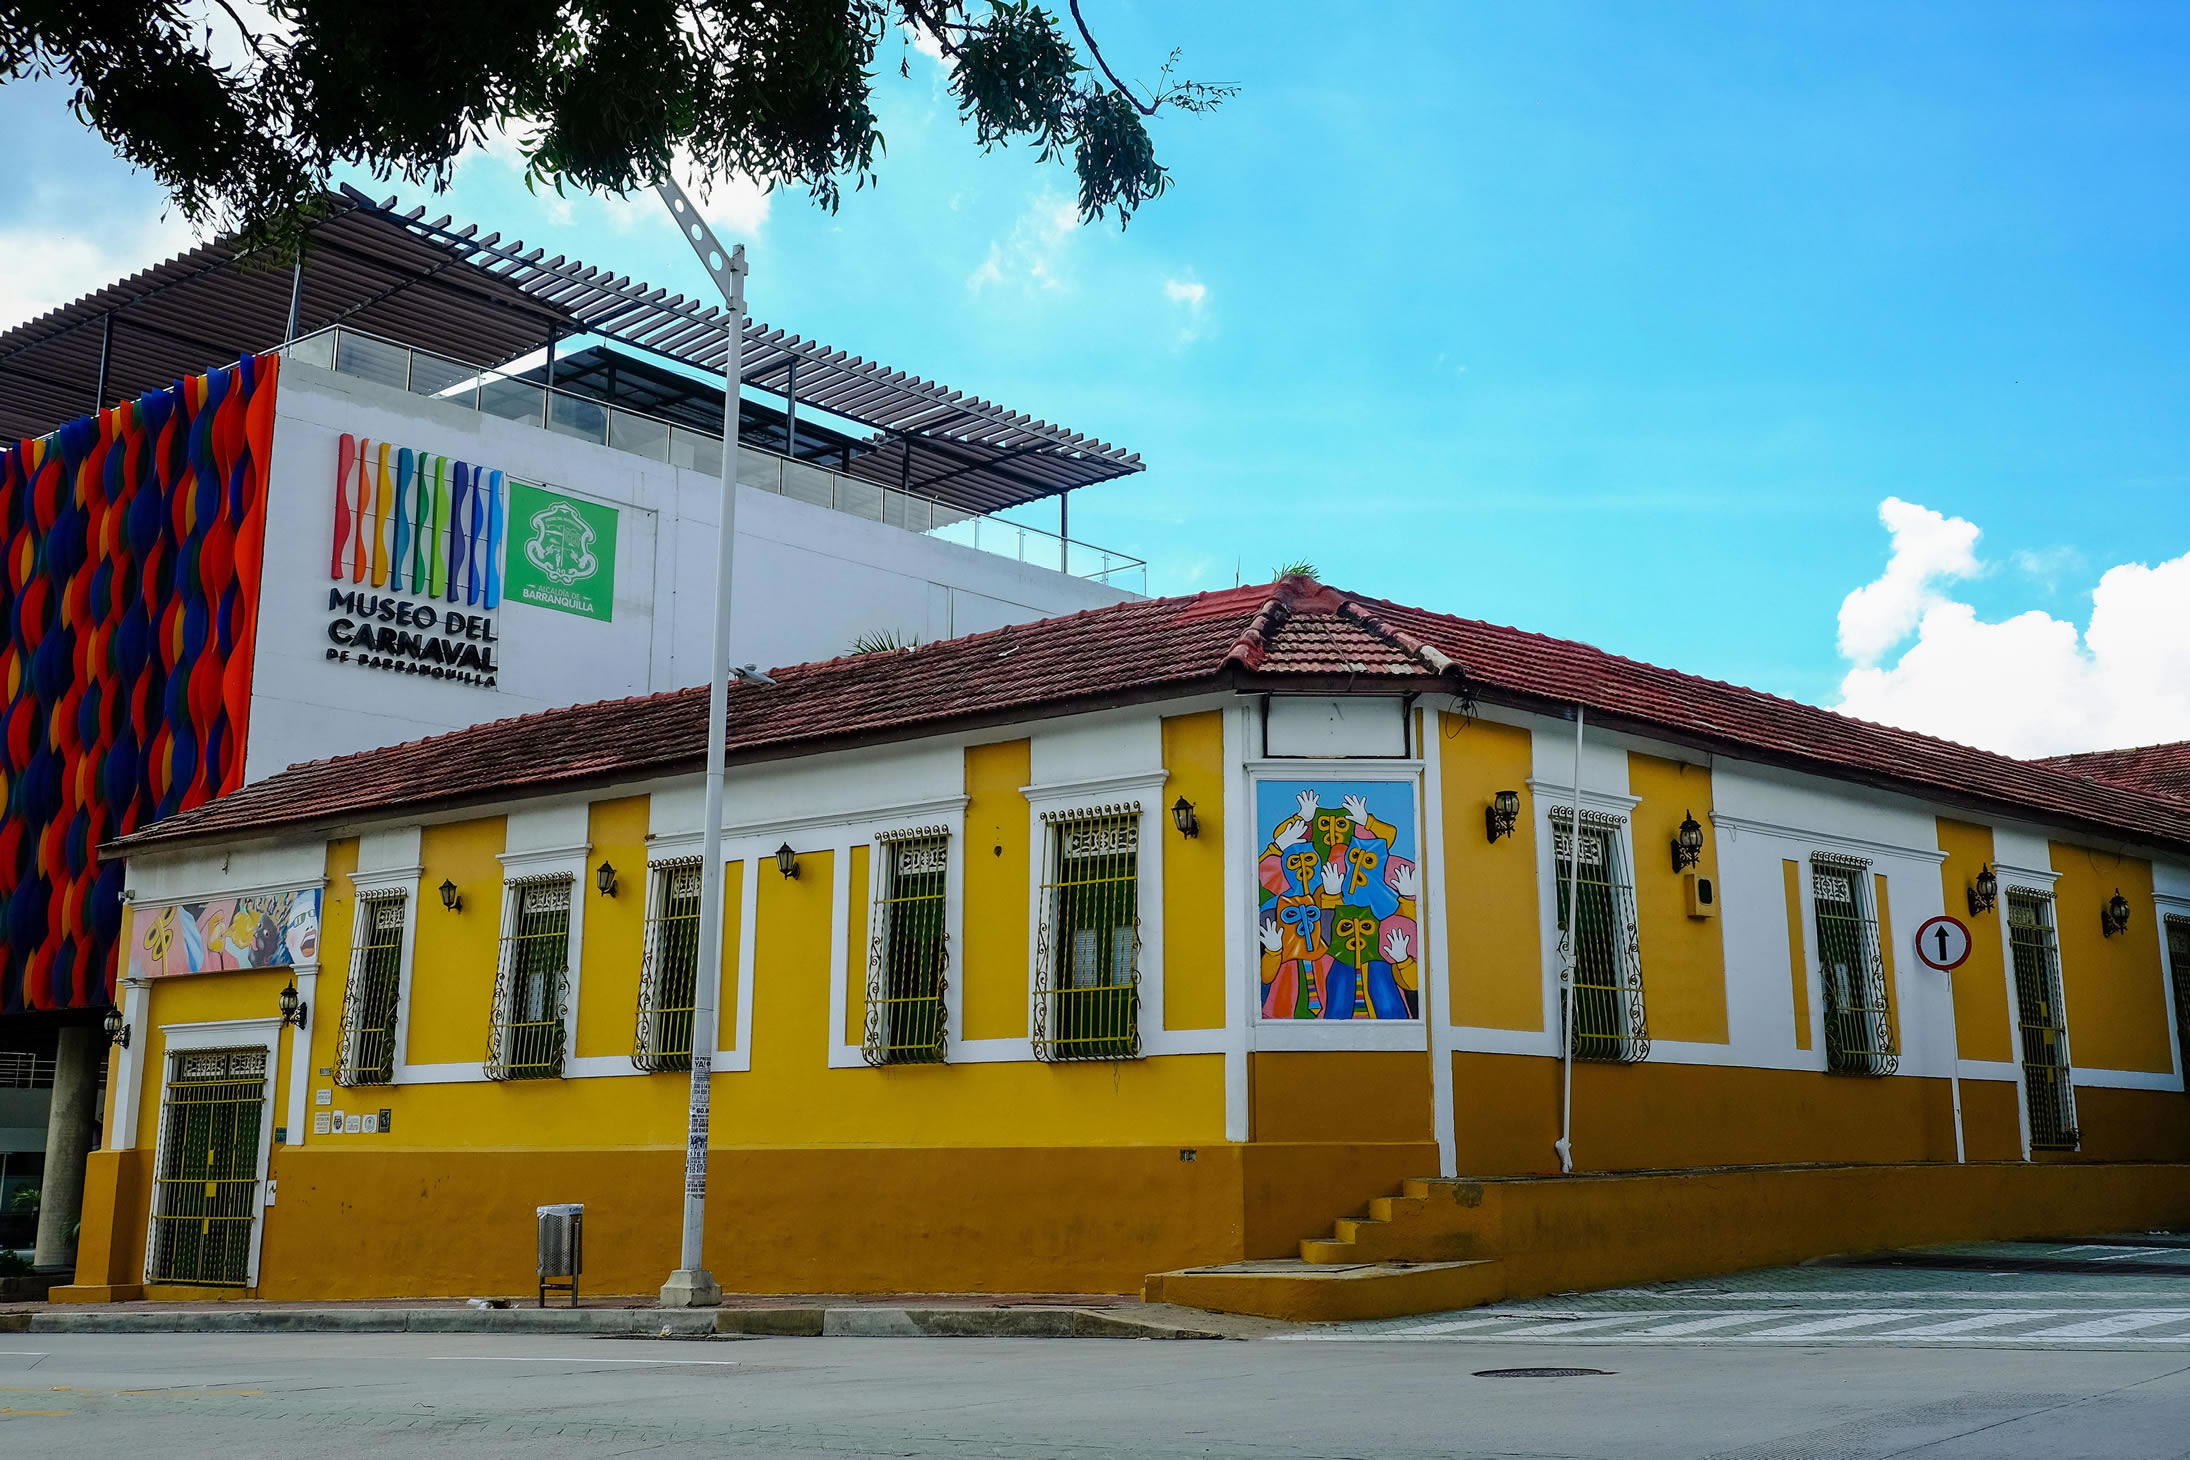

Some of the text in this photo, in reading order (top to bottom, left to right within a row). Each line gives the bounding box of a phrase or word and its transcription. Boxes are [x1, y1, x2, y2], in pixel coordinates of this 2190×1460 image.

[522, 588, 594, 612] BARRANQUILLA
[538, 585, 581, 600] ALCALDÍA DE
[328, 587, 498, 642] MUSEO DEL
[327, 618, 498, 673] CARNAVAL
[326, 648, 496, 688] DE BARRANQUILLA
